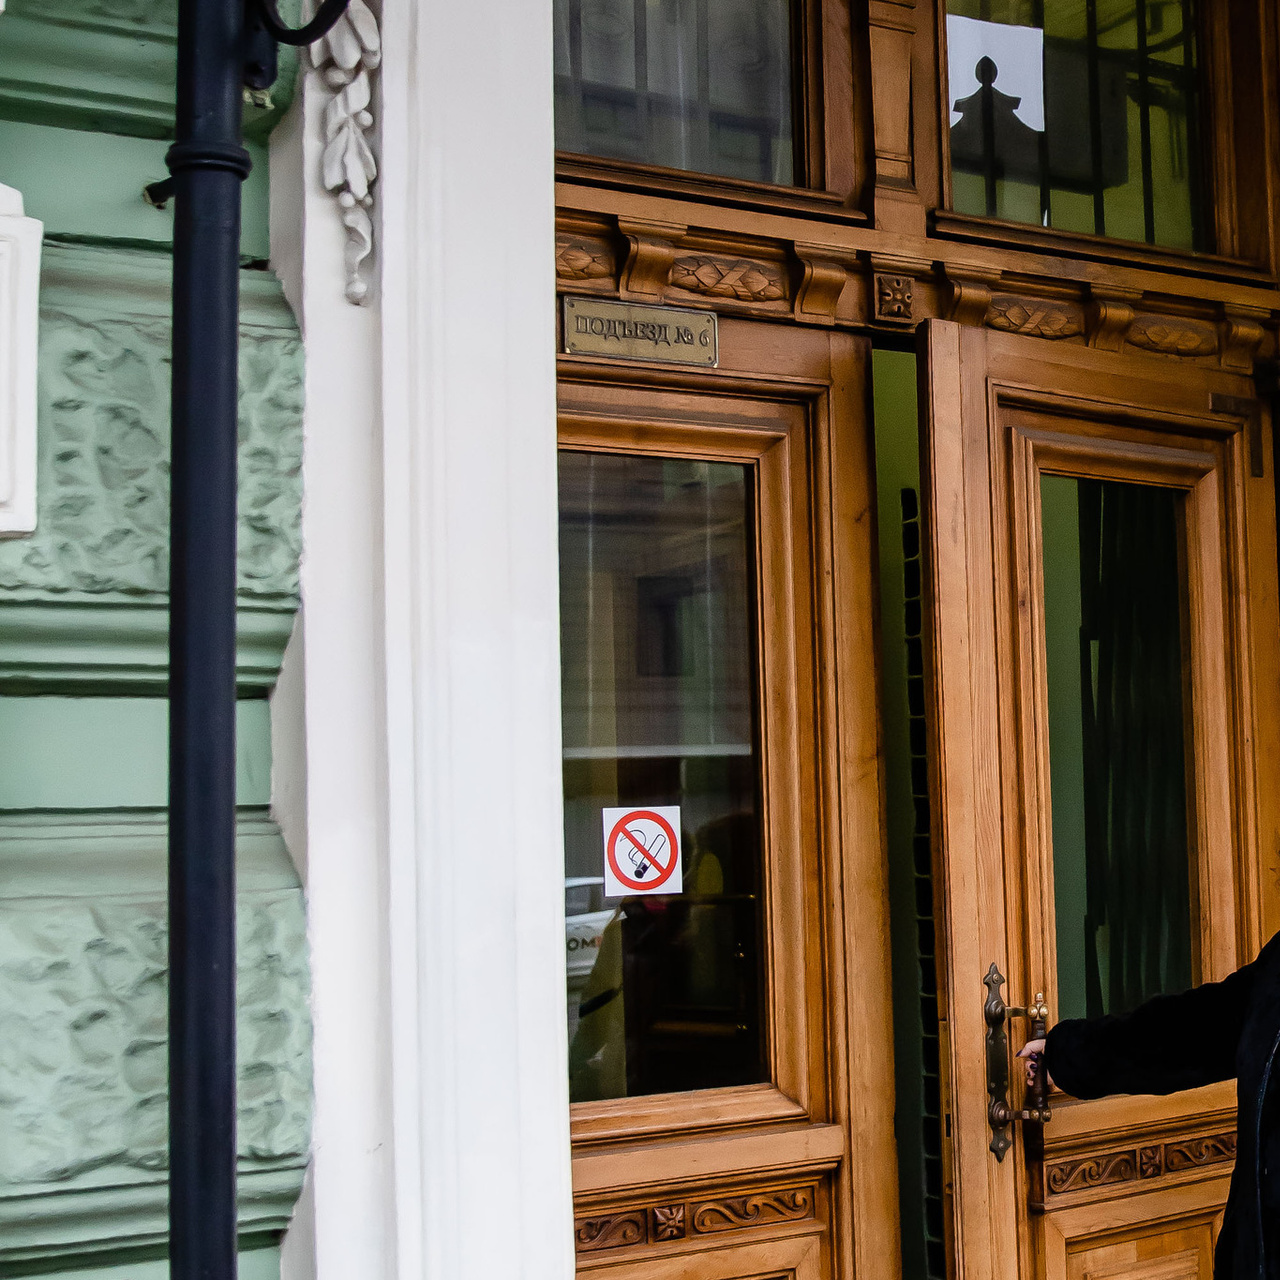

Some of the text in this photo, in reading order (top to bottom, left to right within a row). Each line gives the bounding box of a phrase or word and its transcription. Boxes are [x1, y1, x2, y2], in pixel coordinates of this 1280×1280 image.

[574, 315, 711, 348] ПОДЪЕЗД № 6
